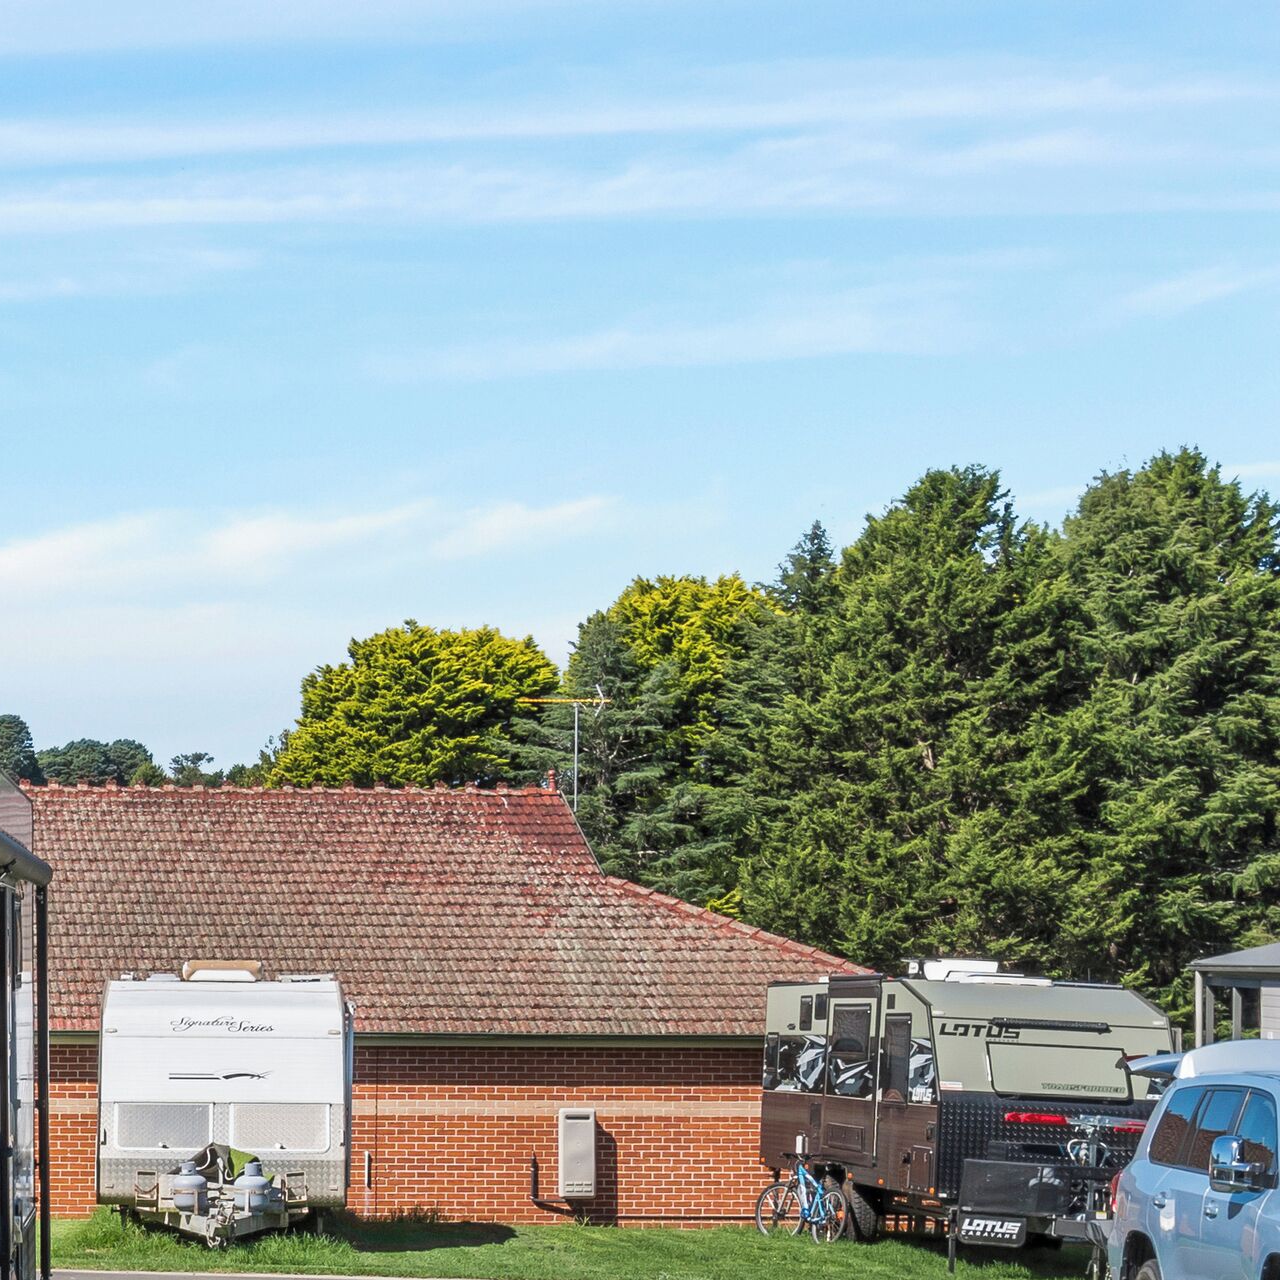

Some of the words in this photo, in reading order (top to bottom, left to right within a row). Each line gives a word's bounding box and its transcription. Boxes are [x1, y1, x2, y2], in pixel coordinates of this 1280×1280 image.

[170, 1016, 239, 1032] Signature
[228, 1020, 275, 1032] Series
[939, 1022, 1021, 1039] LOTUS
[961, 1218, 1021, 1234] LOTUS
[961, 1230, 1017, 1240] CARAVANS
